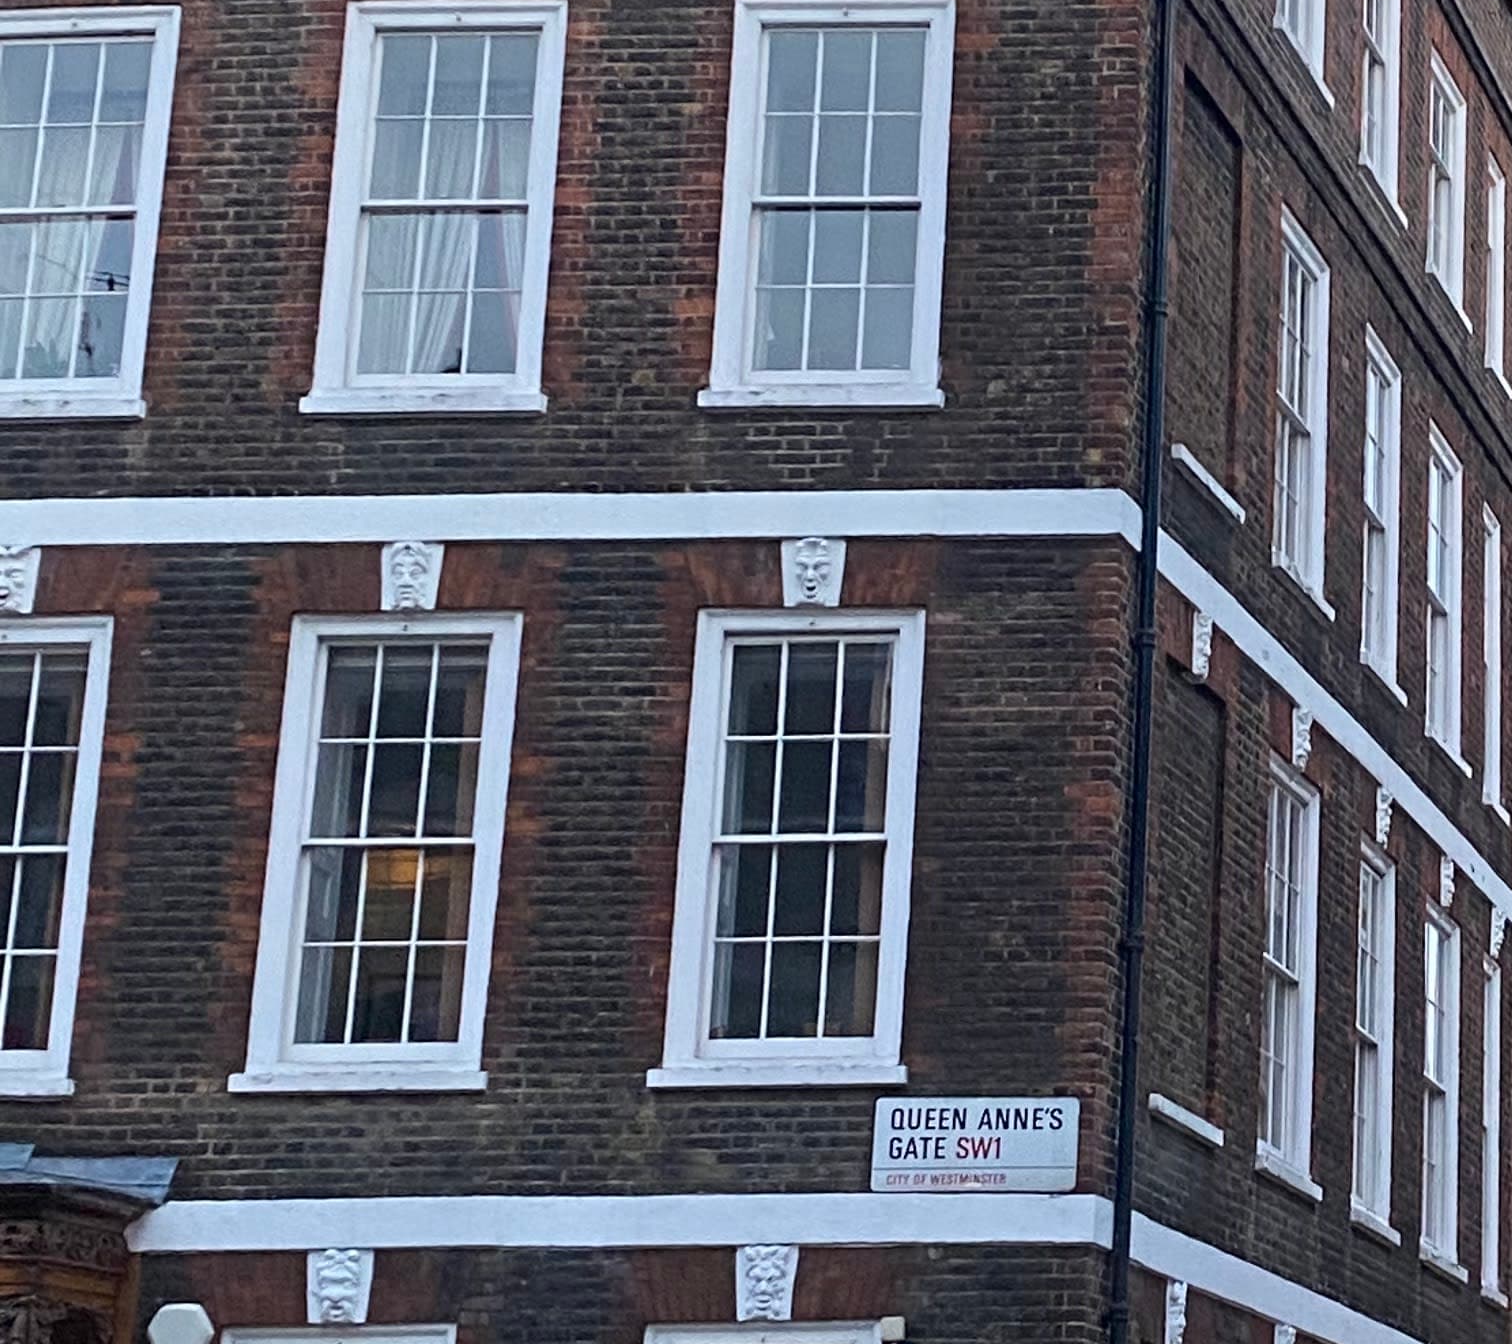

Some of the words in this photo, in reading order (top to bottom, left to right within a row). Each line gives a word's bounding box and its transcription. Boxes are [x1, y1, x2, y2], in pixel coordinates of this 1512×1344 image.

[891, 1107, 968, 1131] QUEEN
[977, 1107, 1064, 1131] ANNE'S
[888, 1136, 947, 1160] GATE
[955, 1136, 1002, 1160] SW1
[886, 1173, 910, 1185] CITY
[913, 1173, 926, 1185] OF
